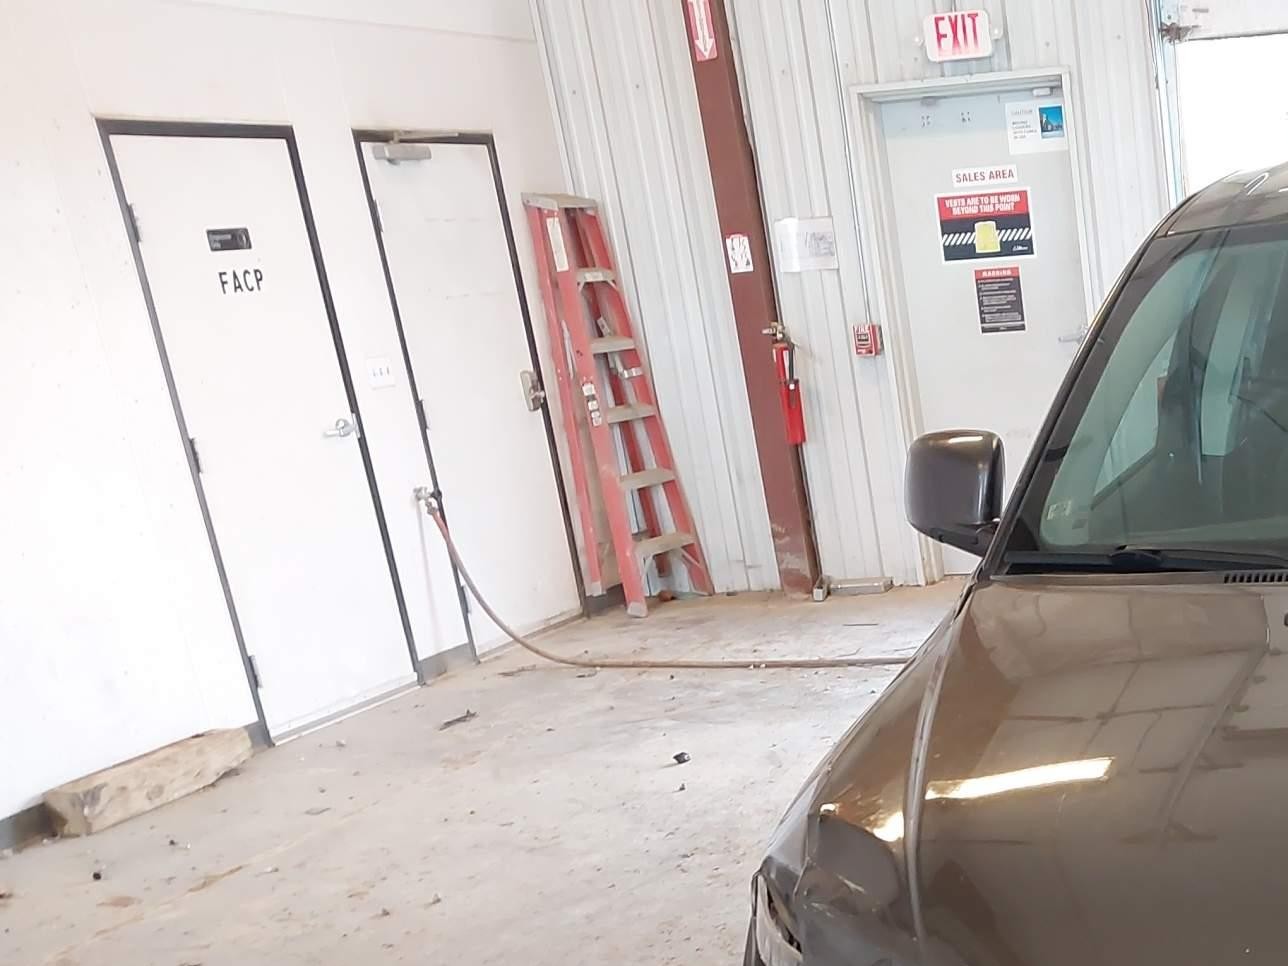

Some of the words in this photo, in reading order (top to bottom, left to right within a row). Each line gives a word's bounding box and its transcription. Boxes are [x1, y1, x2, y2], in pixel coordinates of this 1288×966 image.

[934, 12, 979, 56] EXIT
[955, 171, 986, 183] SALES
[989, 168, 1015, 181] AREA
[218, 268, 263, 294] FACP
